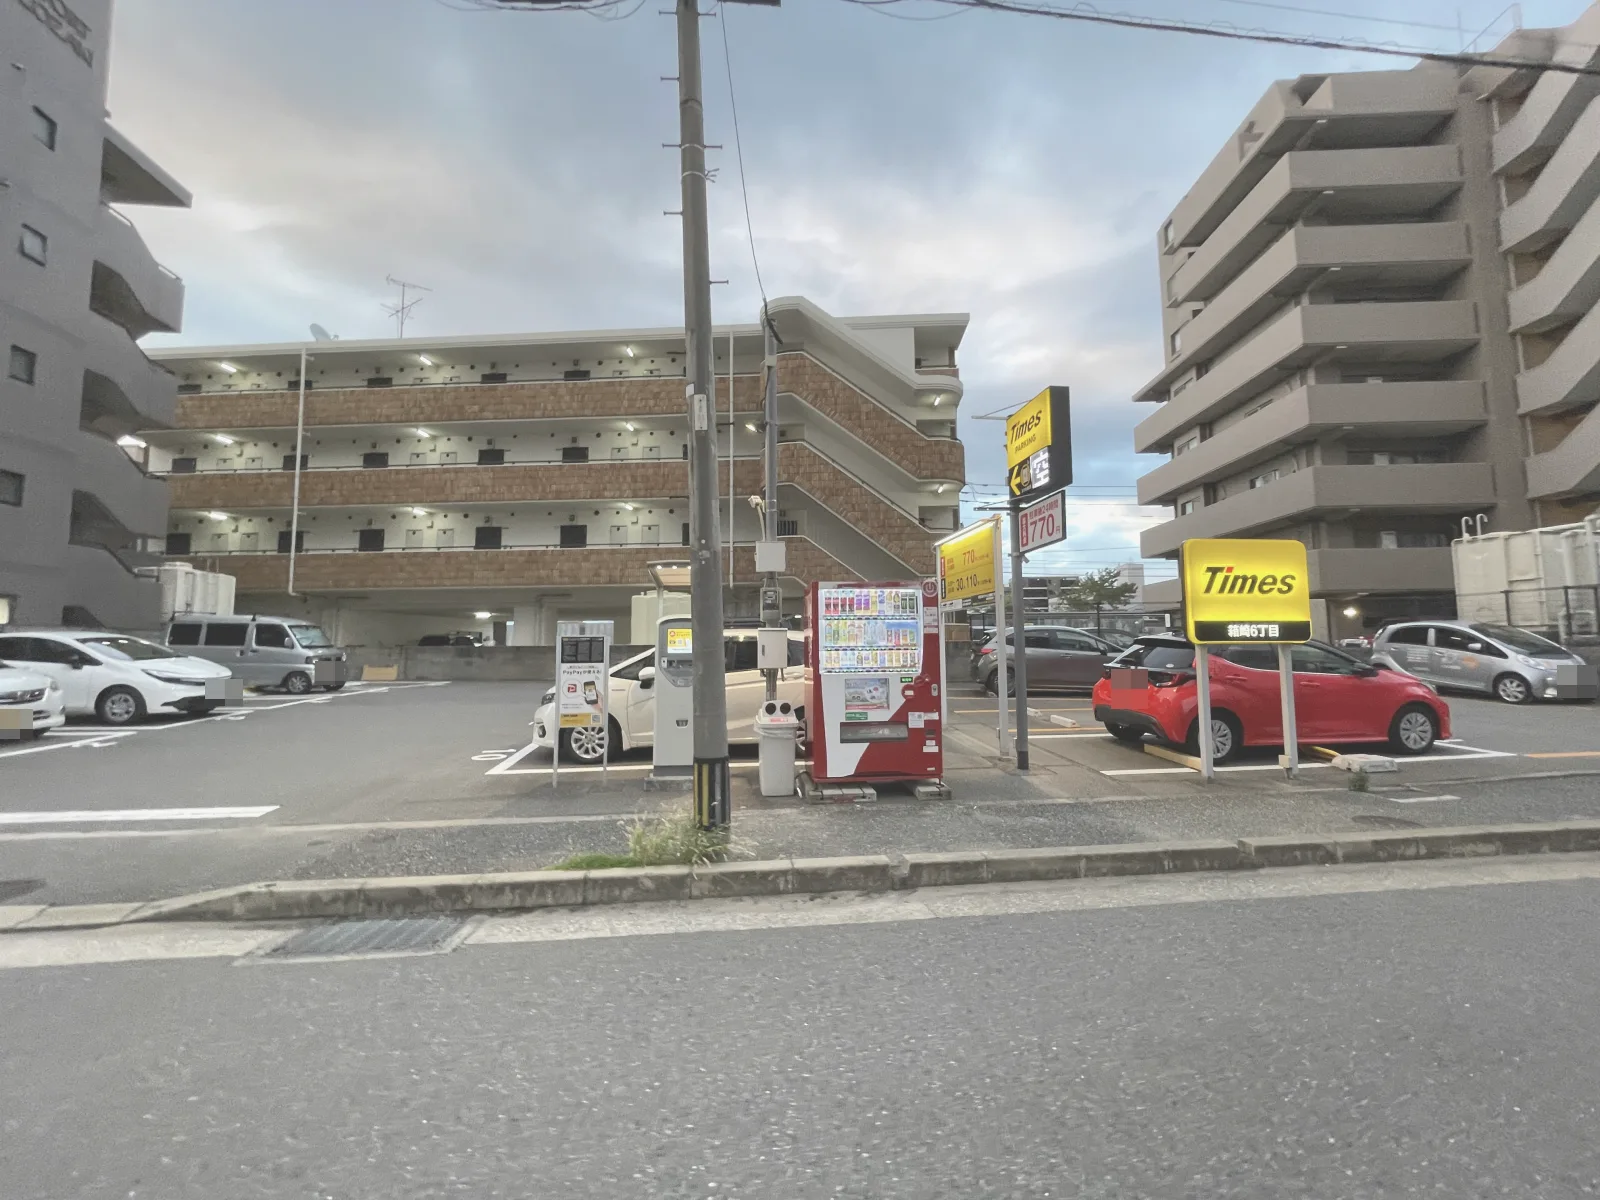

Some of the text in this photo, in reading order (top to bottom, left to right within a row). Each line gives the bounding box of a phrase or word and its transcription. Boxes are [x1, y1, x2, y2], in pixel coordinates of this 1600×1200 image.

[1010, 410, 1042, 445] Times
[1015, 434, 1036, 453] PARKING
[1033, 450, 1049, 489] 空
[1203, 566, 1296, 595] Times
[1227, 624, 1280, 638] 箱崎6丁目
